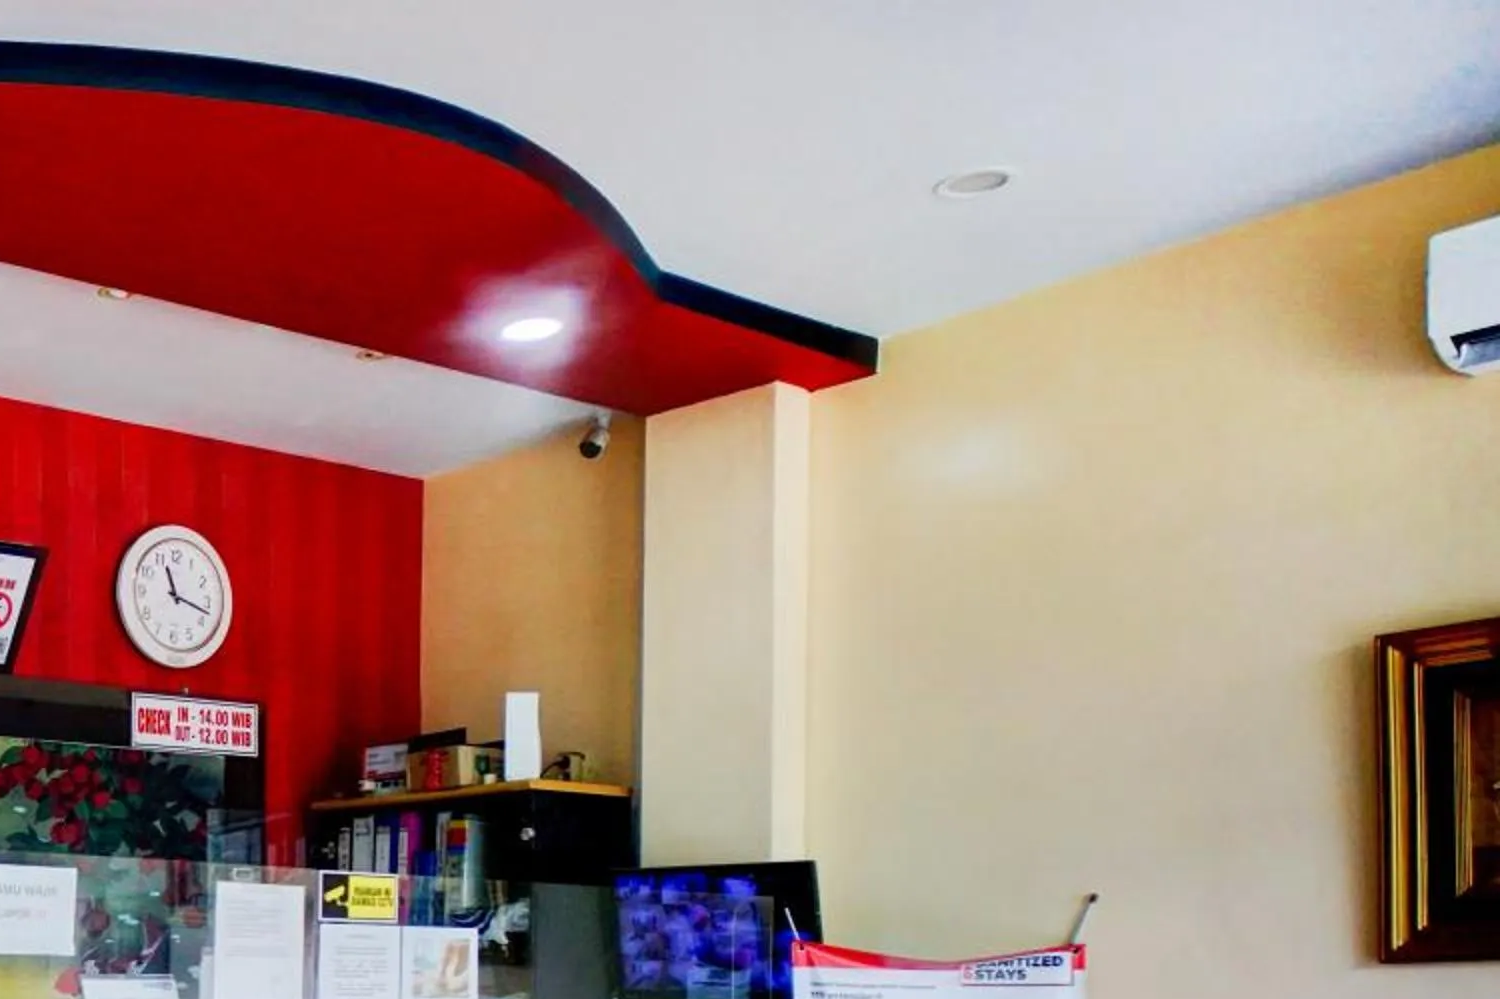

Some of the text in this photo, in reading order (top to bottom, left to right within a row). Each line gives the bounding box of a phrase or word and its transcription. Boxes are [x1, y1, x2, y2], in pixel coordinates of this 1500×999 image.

[171, 550, 183, 565] 12
[138, 707, 171, 736] CHECK
[177, 707, 189, 722] IN
[199, 708, 229, 726] 14.00
[231, 711, 252, 728] WIB
[175, 726, 191, 742] OUT
[199, 728, 229, 744] 12.00
[231, 731, 251, 747] WIB
[975, 968, 1027, 981] STAYS
